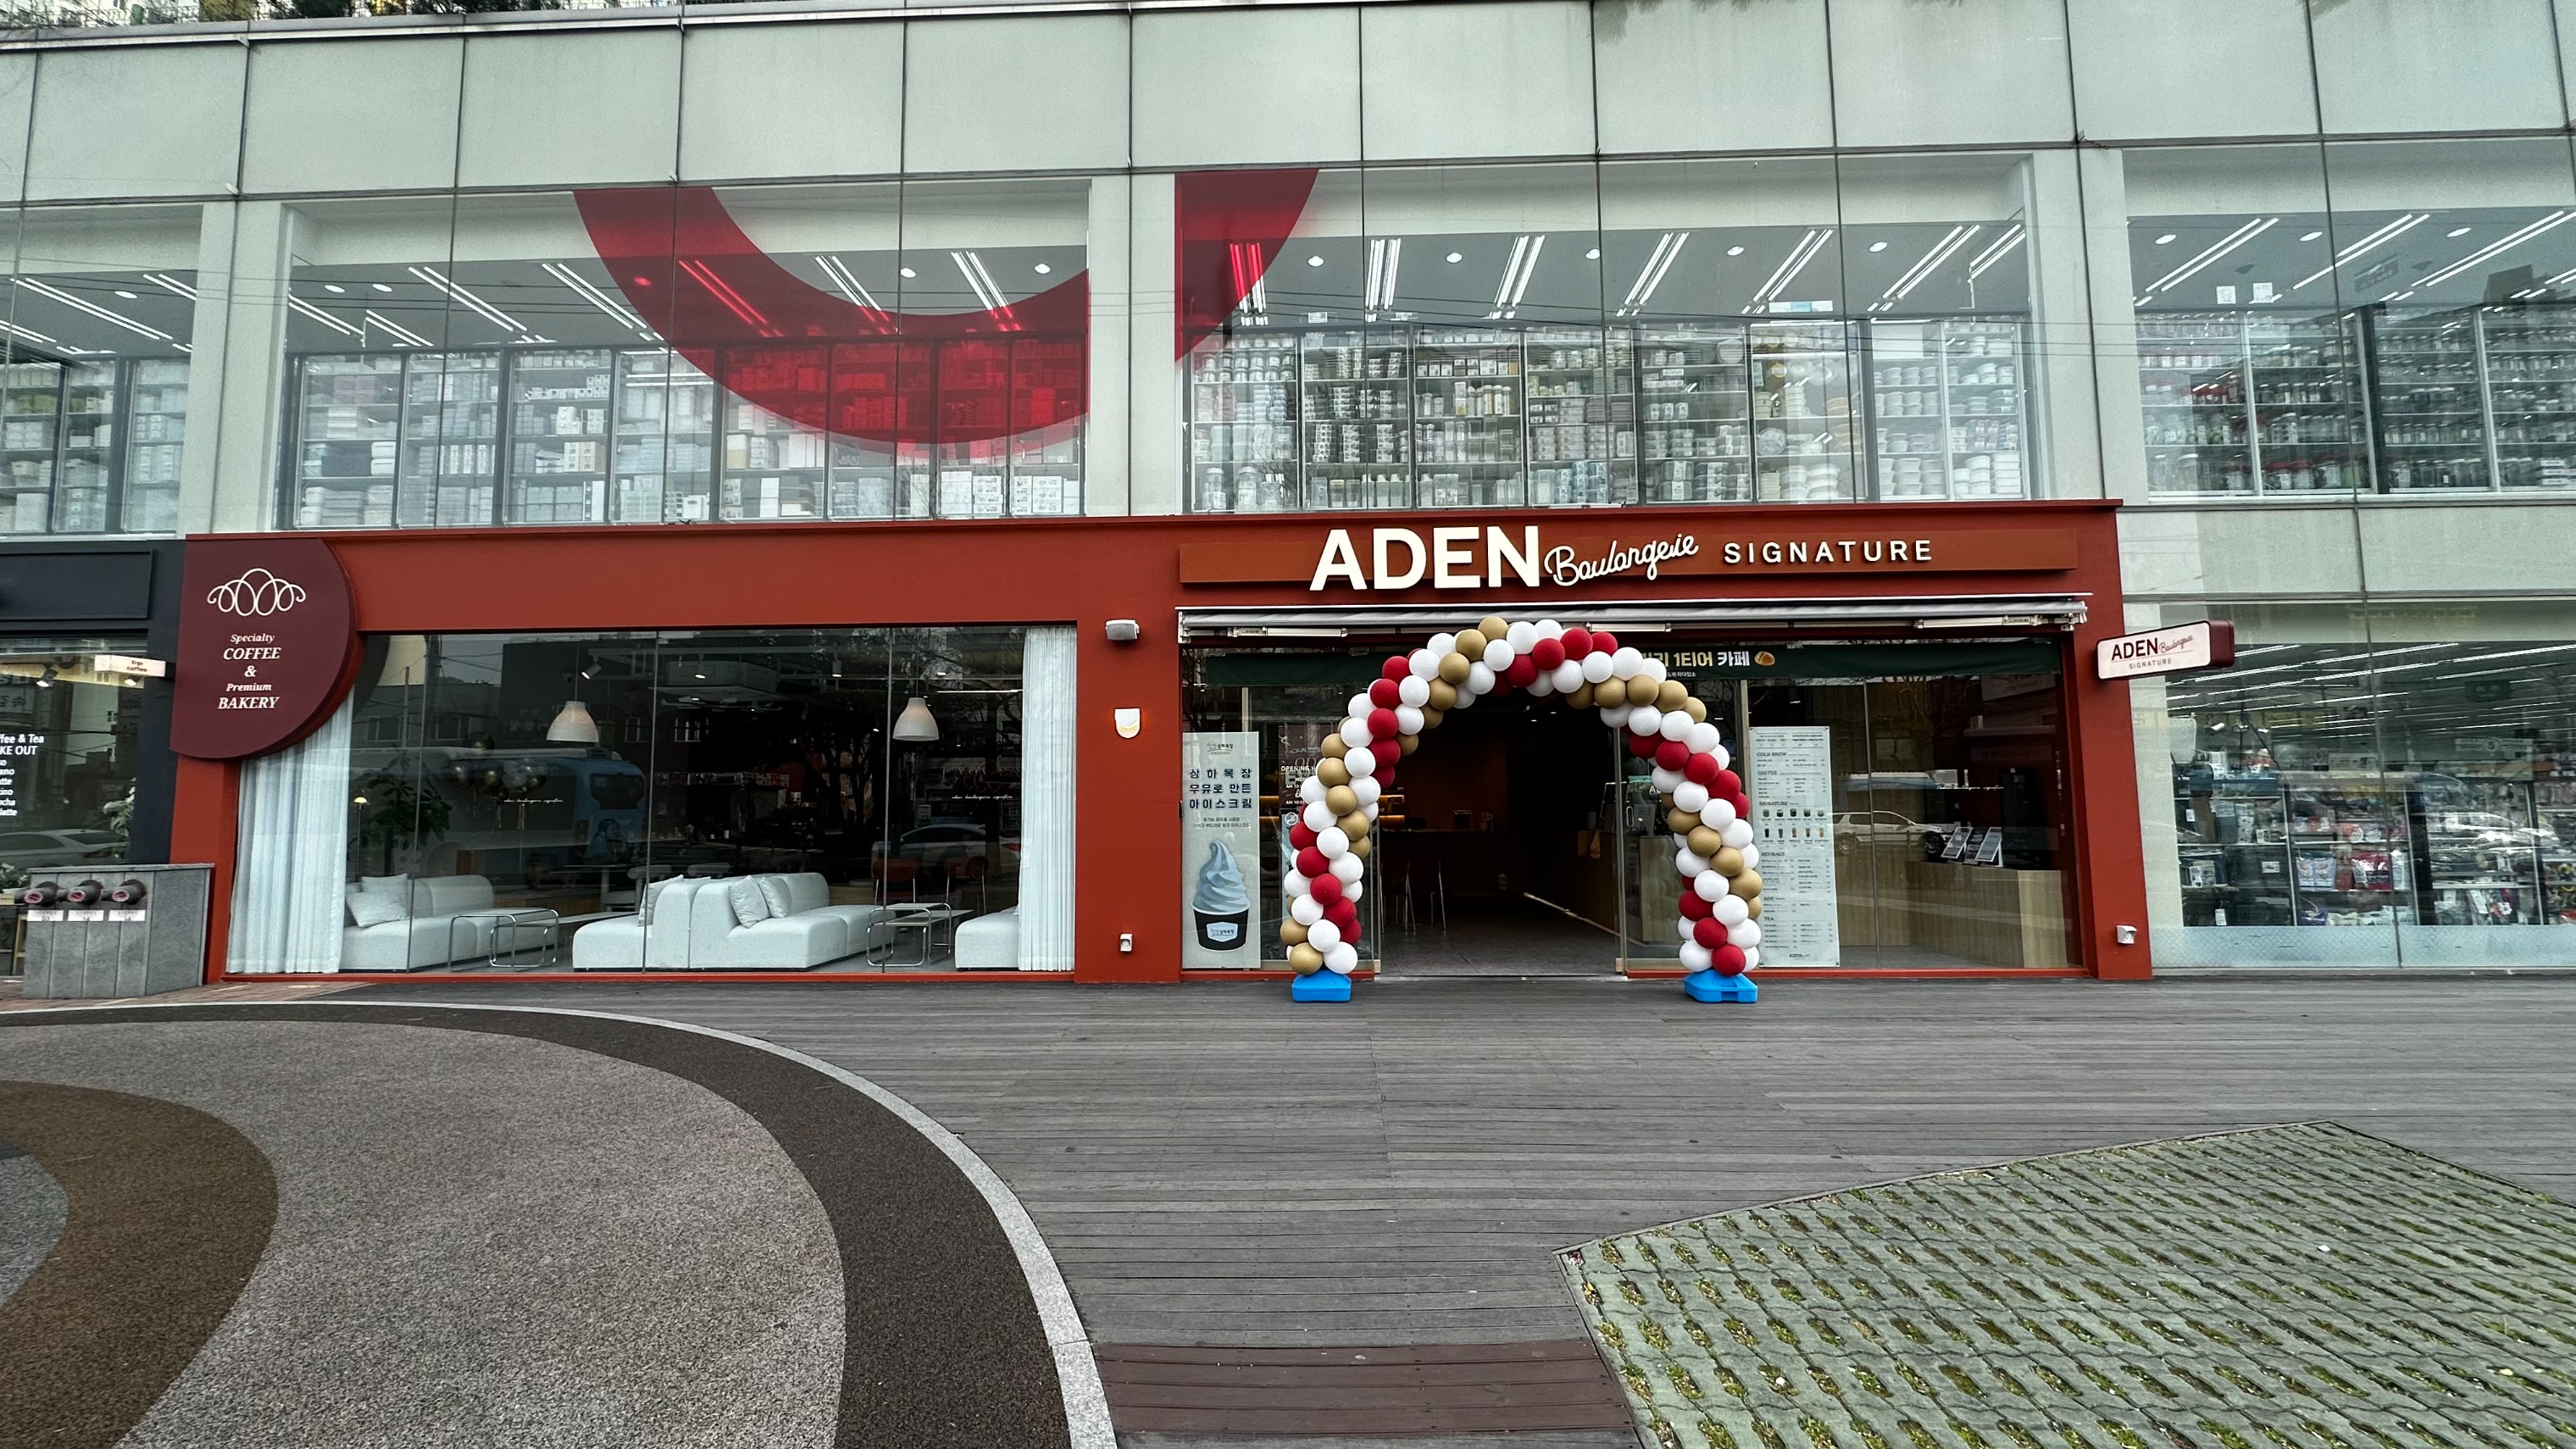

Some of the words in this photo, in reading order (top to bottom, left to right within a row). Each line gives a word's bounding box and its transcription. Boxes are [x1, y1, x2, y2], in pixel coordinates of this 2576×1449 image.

[1309, 525, 1541, 591] ADEN
[1543, 534, 1699, 587] Boulangerie
[1724, 539, 1933, 564] SIGNATURE
[230, 633, 275, 644] Specialty
[223, 647, 282, 660] COFFEE
[2111, 637, 2158, 660] ADEN
[1673, 651, 1713, 668] 1티어
[1717, 651, 1751, 667] 카페
[2129, 658, 2173, 669] SIGNATURE
[244, 664, 258, 678] &
[225, 682, 272, 692] Premium
[217, 697, 280, 710] BAKERY
[18, 733, 26, 743] &
[28, 733, 45, 743] Tea
[14, 746, 38, 756] OUT
[1190, 784, 1223, 794] 우유로
[1230, 783, 1251, 794] 만든
[1189, 798, 1253, 809] 아이스크림
